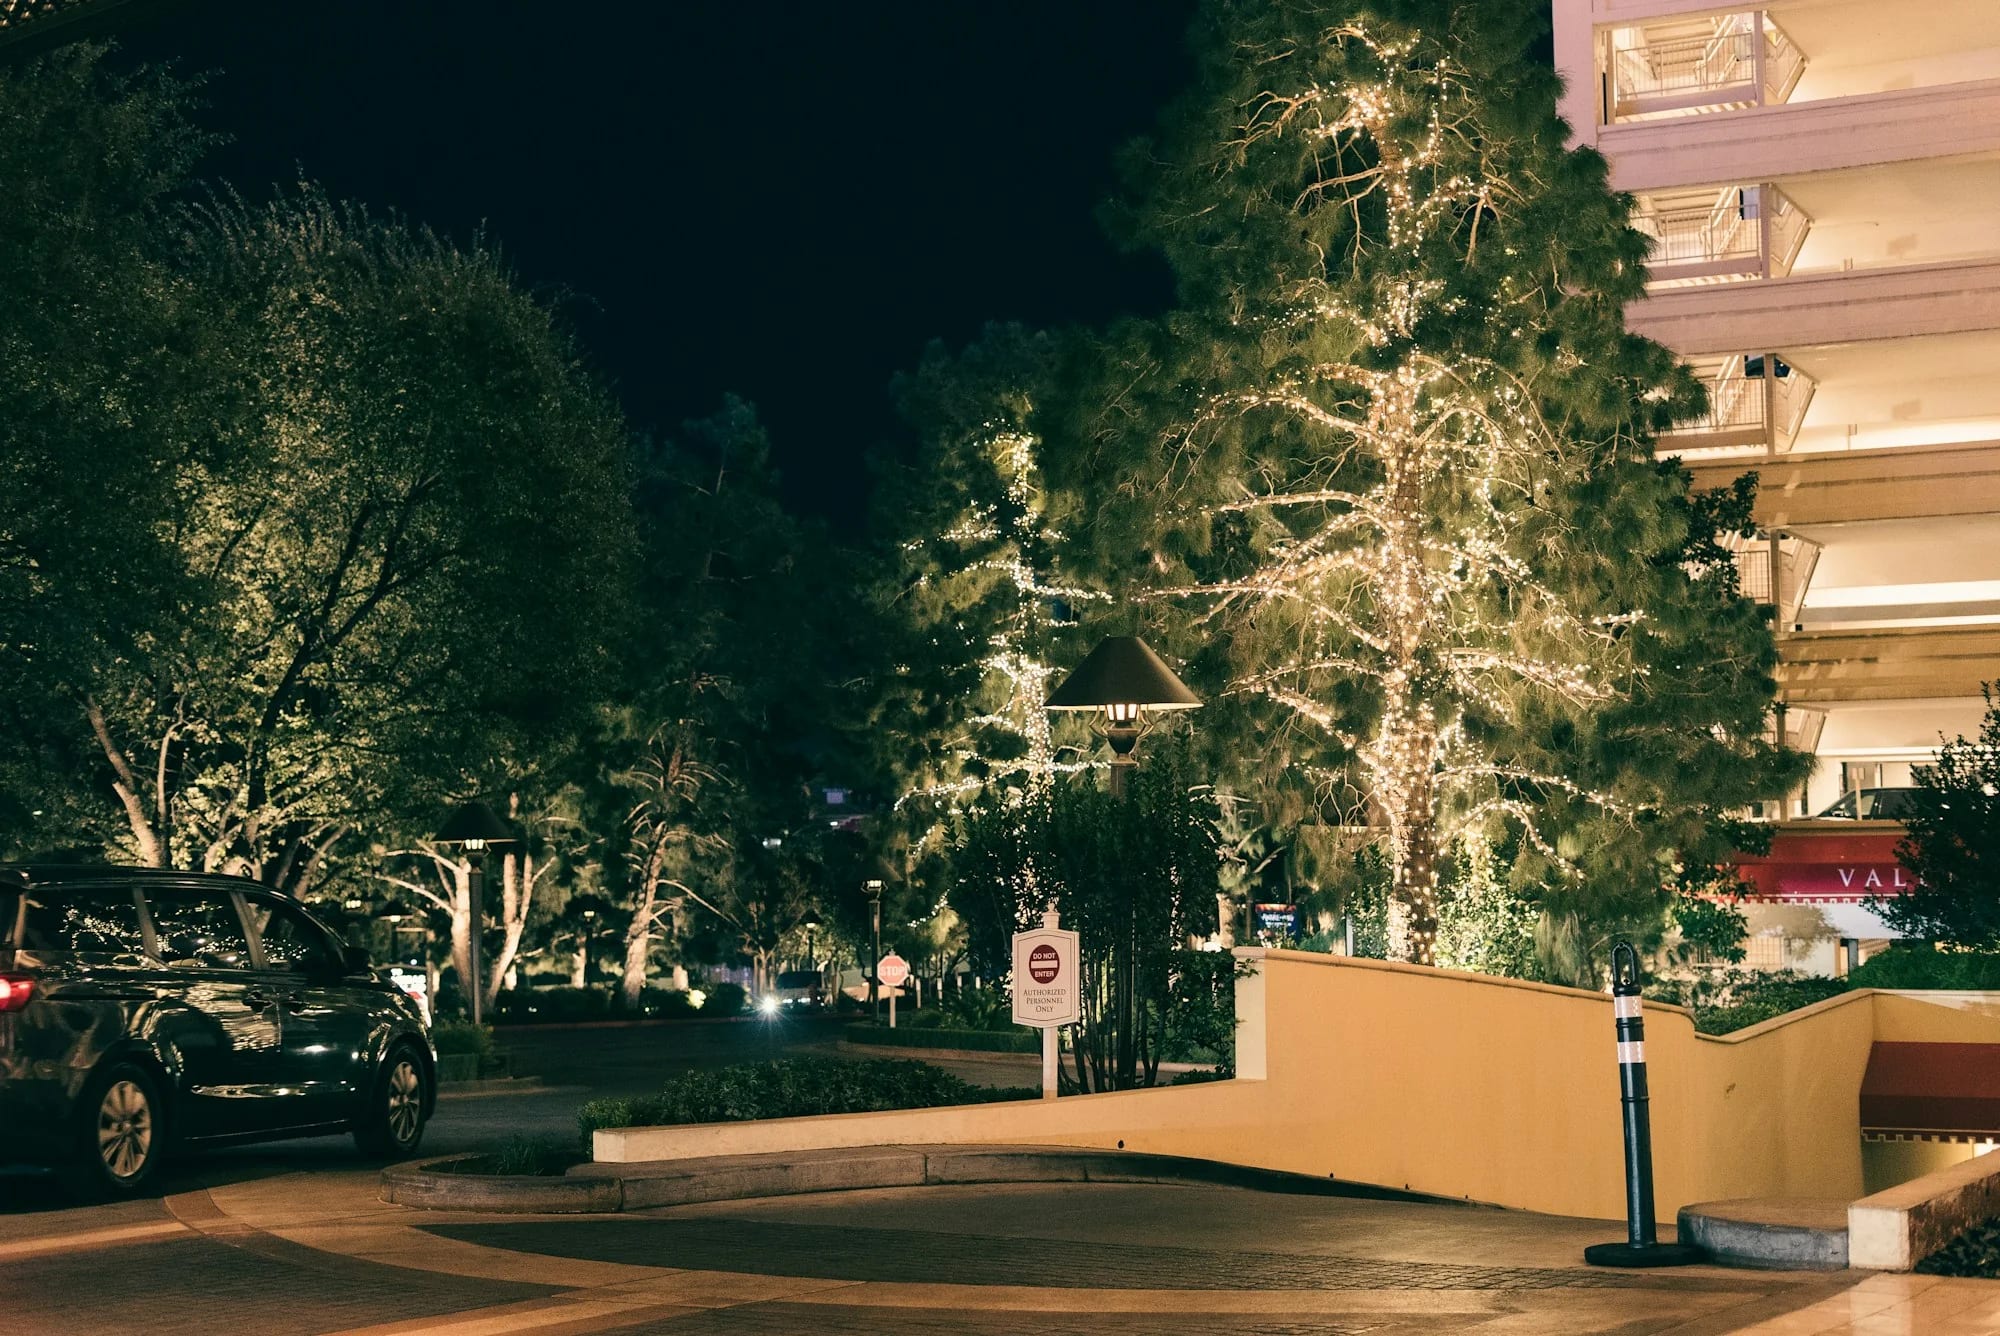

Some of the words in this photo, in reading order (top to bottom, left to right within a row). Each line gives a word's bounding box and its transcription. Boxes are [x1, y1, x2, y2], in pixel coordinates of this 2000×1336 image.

[1838, 868, 1928, 887] VAL
[879, 966, 905, 977] STOP
[1034, 970, 1054, 978] ENTER
[1023, 988, 1066, 996] AUTHORIZED
[1026, 997, 1064, 1005] PERSONNEL
[1035, 1005, 1054, 1013] ONLY
